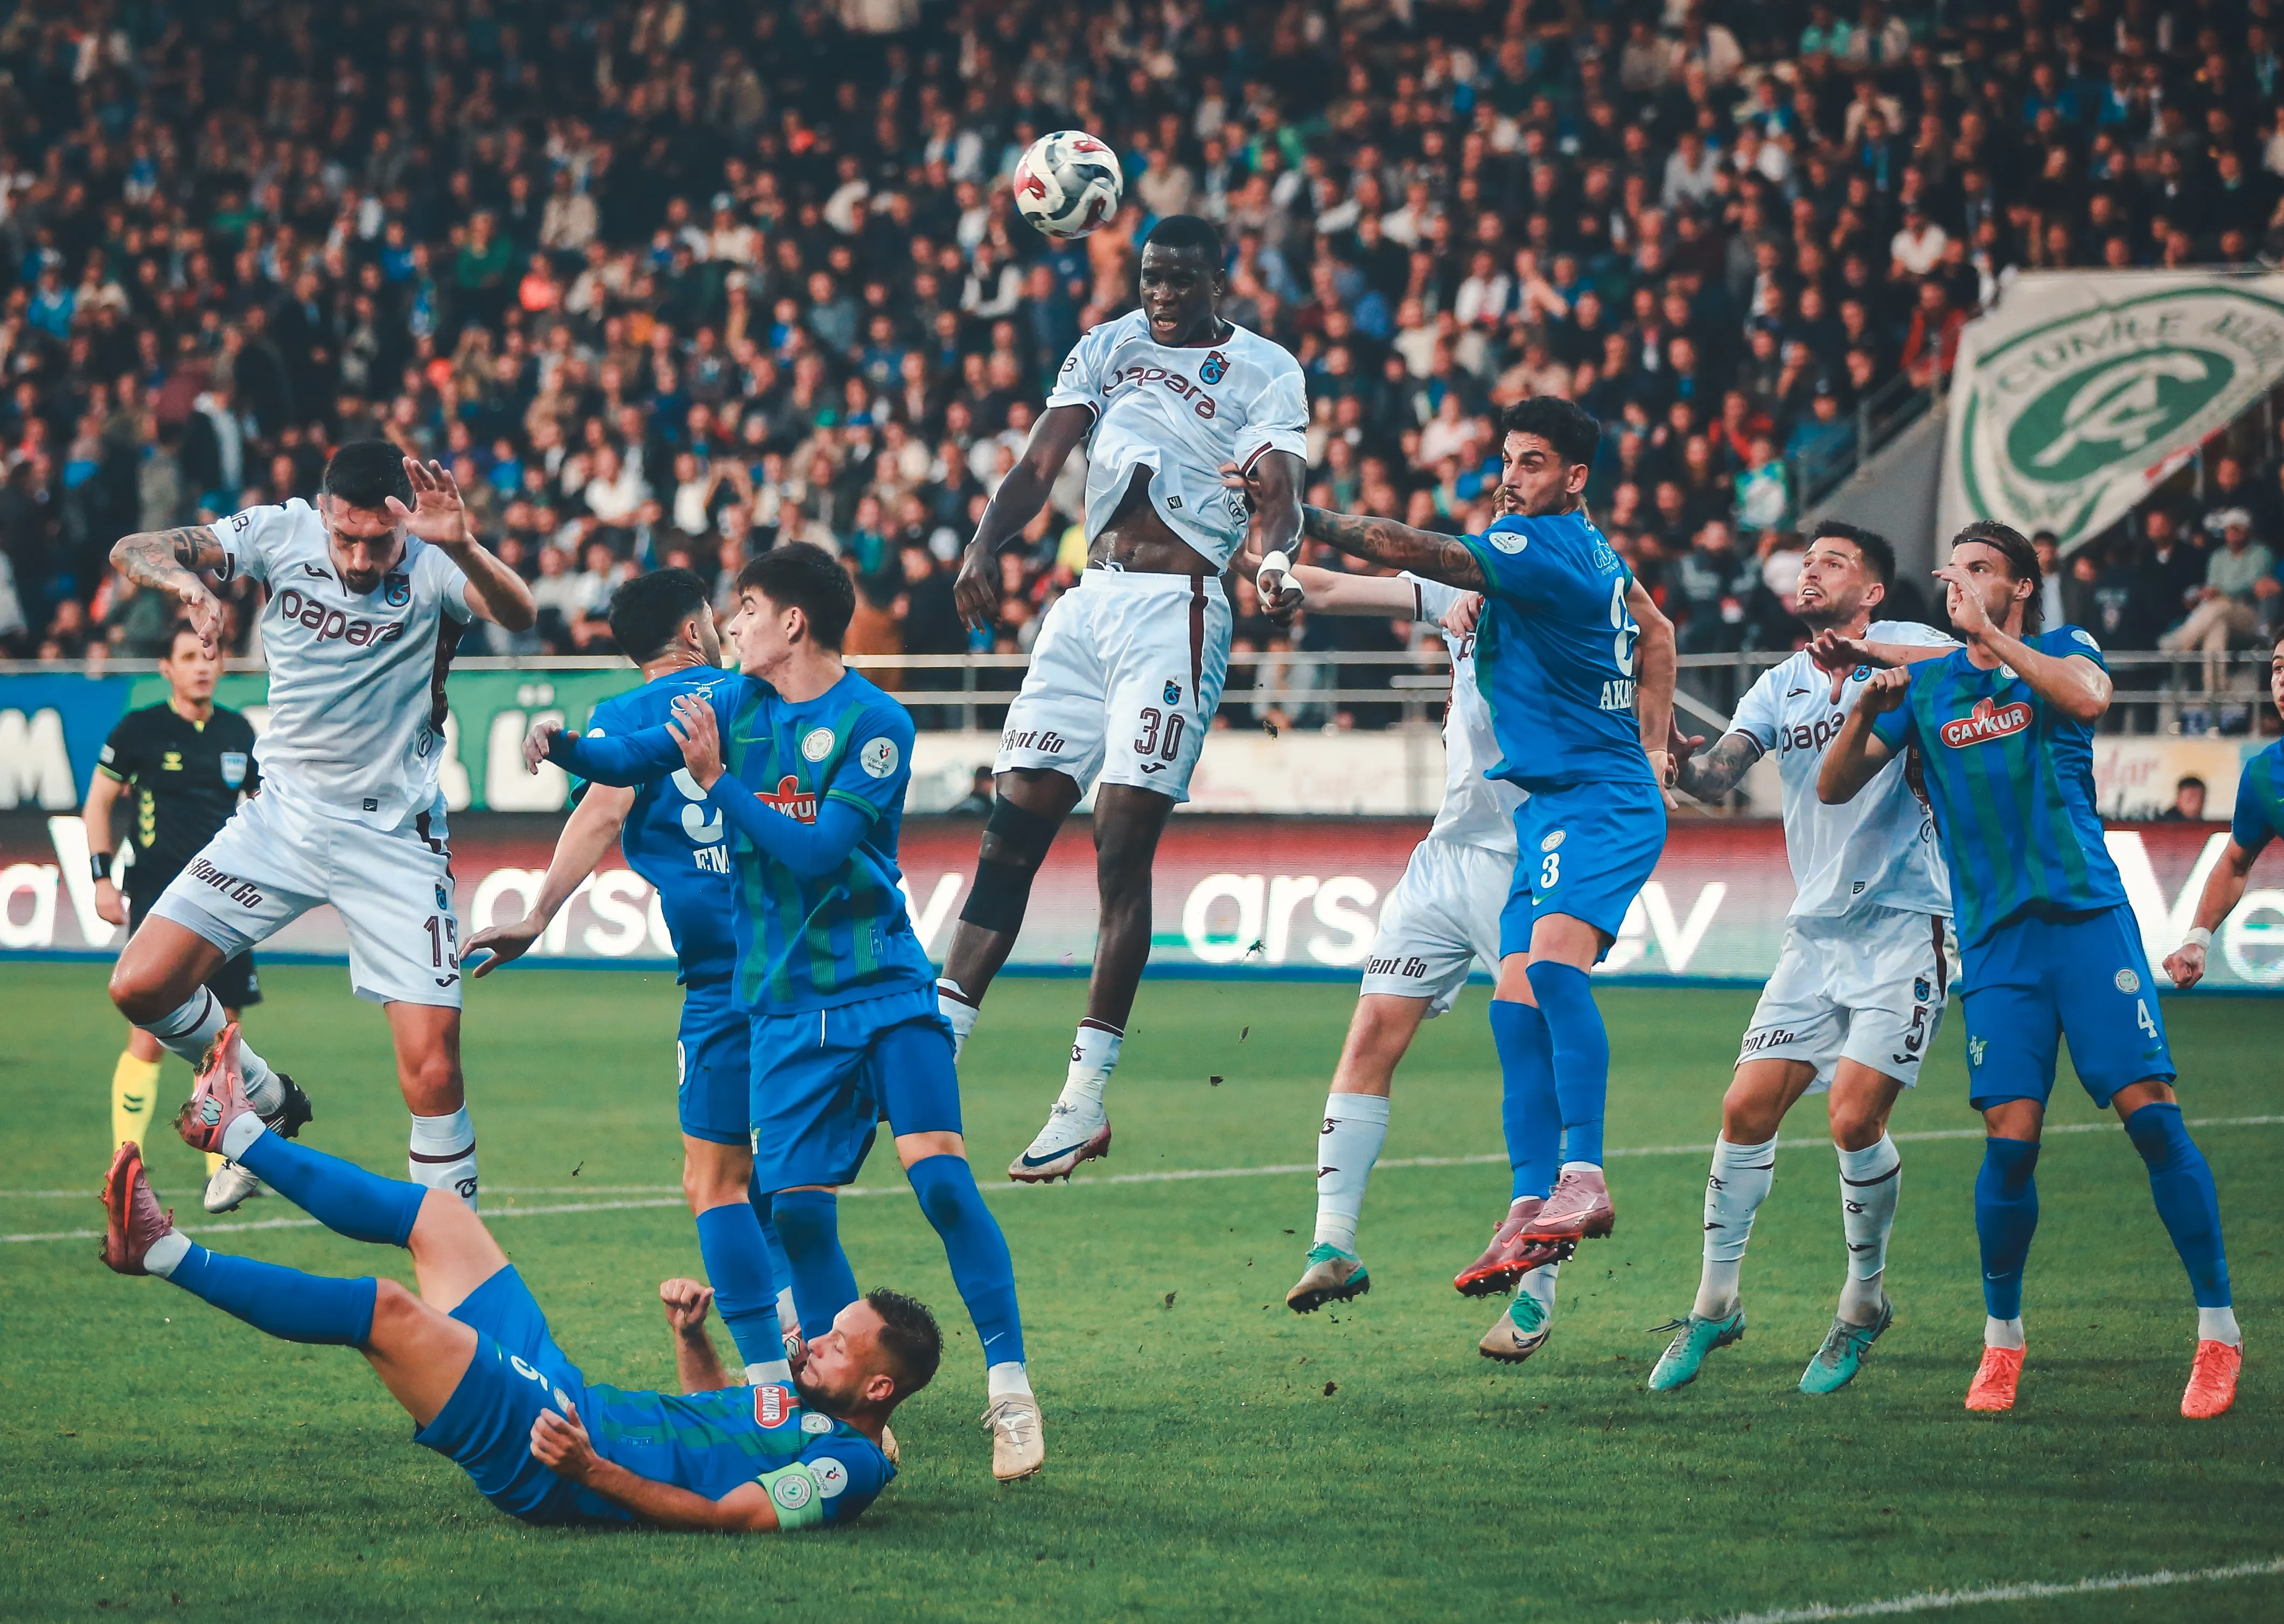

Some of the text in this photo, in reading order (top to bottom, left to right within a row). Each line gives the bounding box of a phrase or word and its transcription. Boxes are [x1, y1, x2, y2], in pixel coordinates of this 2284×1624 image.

[1102, 367, 1216, 419] papara
[282, 590, 404, 647] papara
[1037, 731, 1065, 753] Go
[1134, 706, 1185, 761] 30
[1780, 712, 1846, 760] papa
[1948, 709, 2025, 745] ÇAYKUR
[187, 858, 263, 909] Rent Go
[1540, 852, 1560, 889] 3
[423, 915, 459, 970] 15
[1401, 957, 1428, 978] Go
[1904, 1005, 1928, 1052] 5
[2137, 998, 2158, 1039] 4
[1742, 1029, 1794, 1053] ent Go
[758, 1387, 780, 1422] ÇAYKUR
